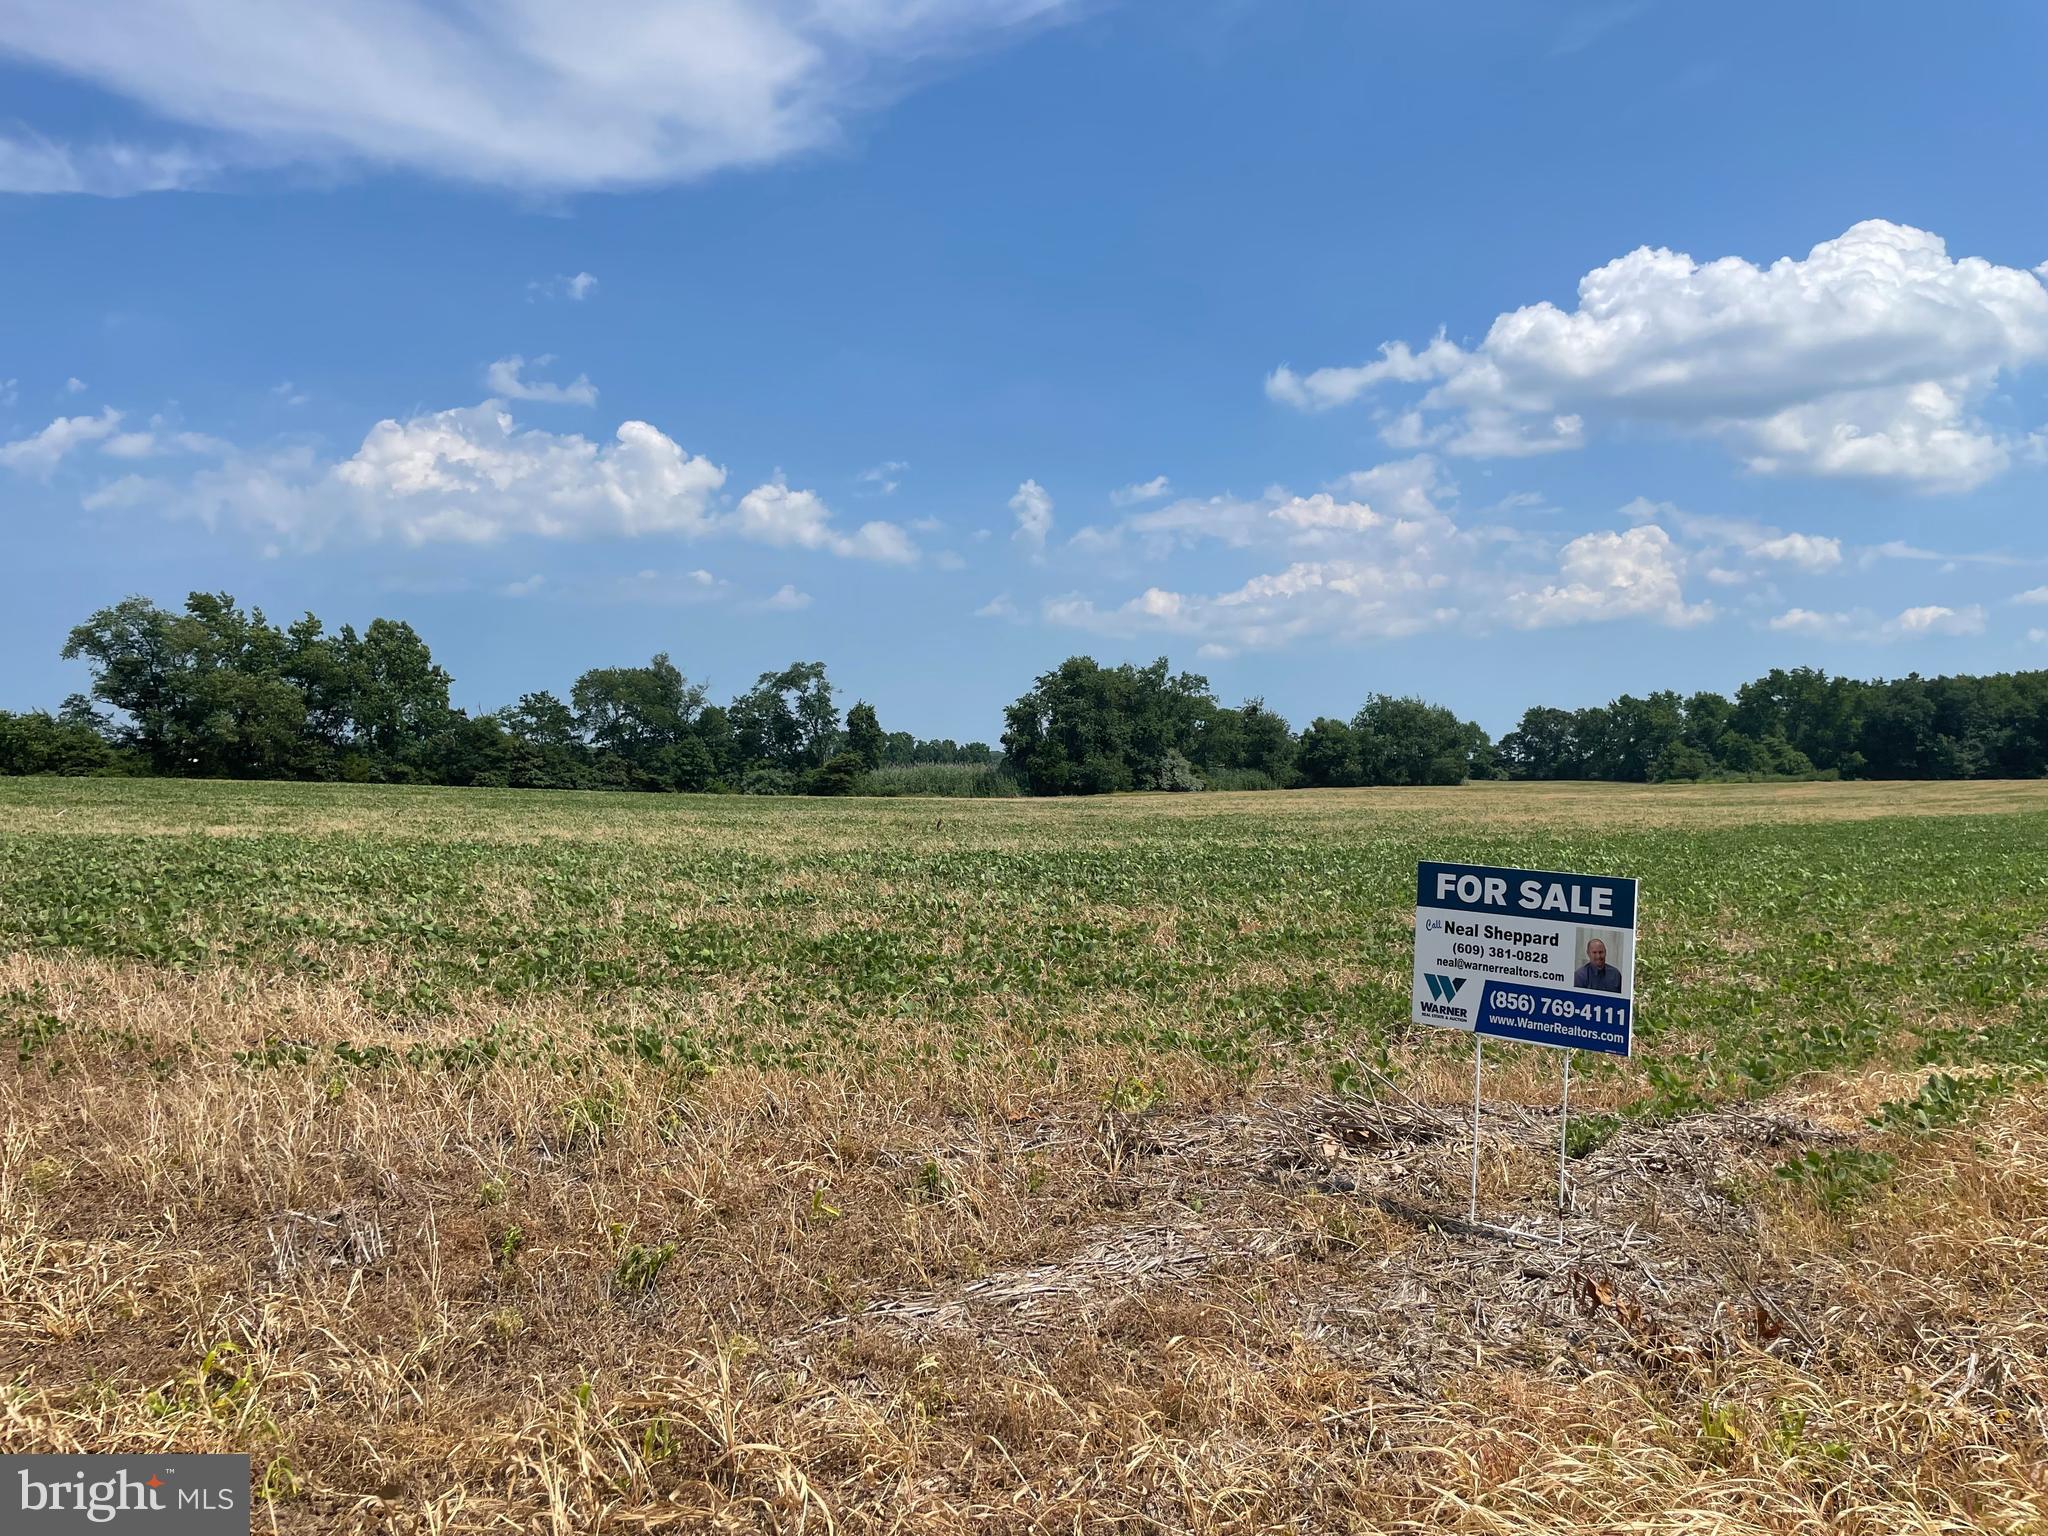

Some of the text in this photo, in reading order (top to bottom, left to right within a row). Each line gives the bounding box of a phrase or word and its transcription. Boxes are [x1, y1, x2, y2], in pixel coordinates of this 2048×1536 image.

[1436, 872, 1613, 917] FOR SALE
[1426, 919, 1559, 946] Call Neal Sheppard
[1452, 942, 1548, 964] (609) 381-0828
[1436, 958, 1565, 982] neal@warnerrealtors.com
[1421, 1001, 1467, 1018] WARNER
[1489, 990, 1625, 1026] (856) 769-4111
[1489, 1014, 1624, 1043] www.WarnerRealtors.com
